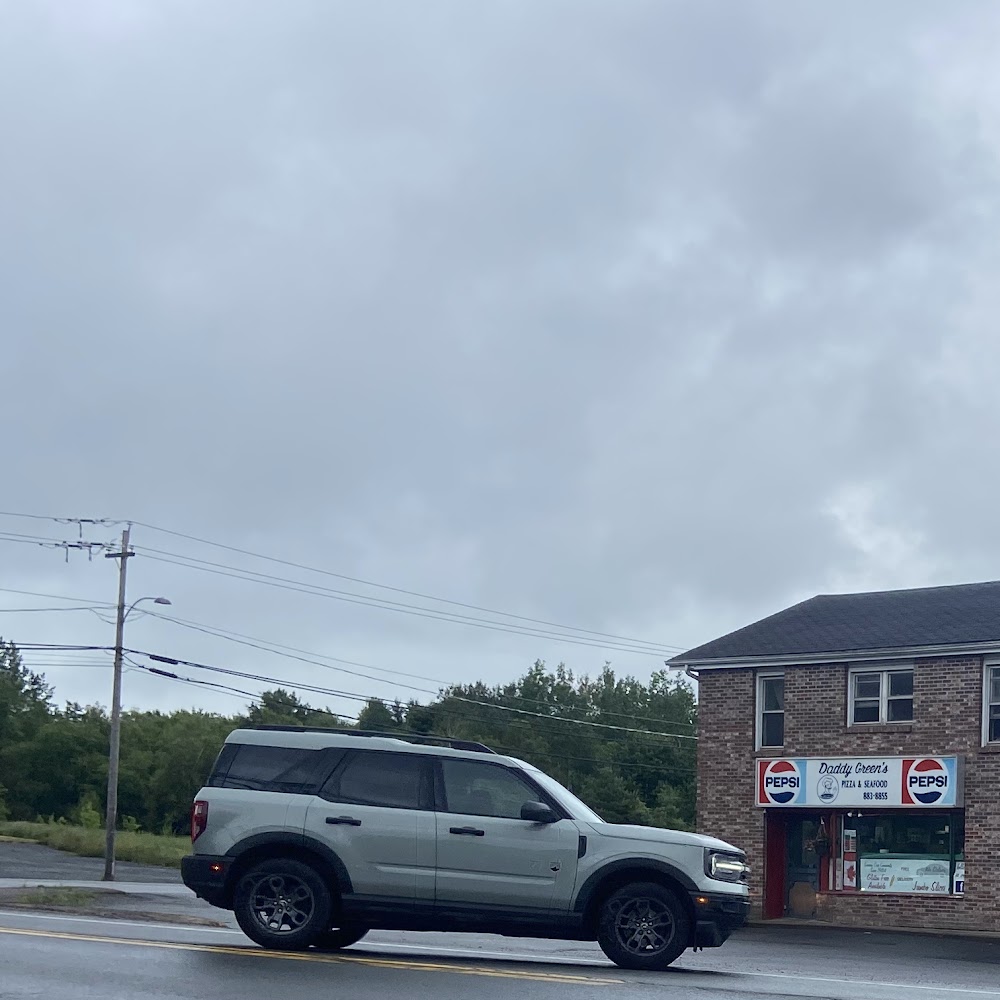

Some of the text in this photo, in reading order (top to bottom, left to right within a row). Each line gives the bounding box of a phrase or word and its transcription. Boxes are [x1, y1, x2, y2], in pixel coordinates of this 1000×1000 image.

[818, 762, 888, 778] Daddy Green's
[765, 776, 800, 788] PEPSI
[841, 780, 856, 788] PIZZA
[863, 780, 888, 788] SEAFOOD
[909, 775, 948, 788] PEPSI
